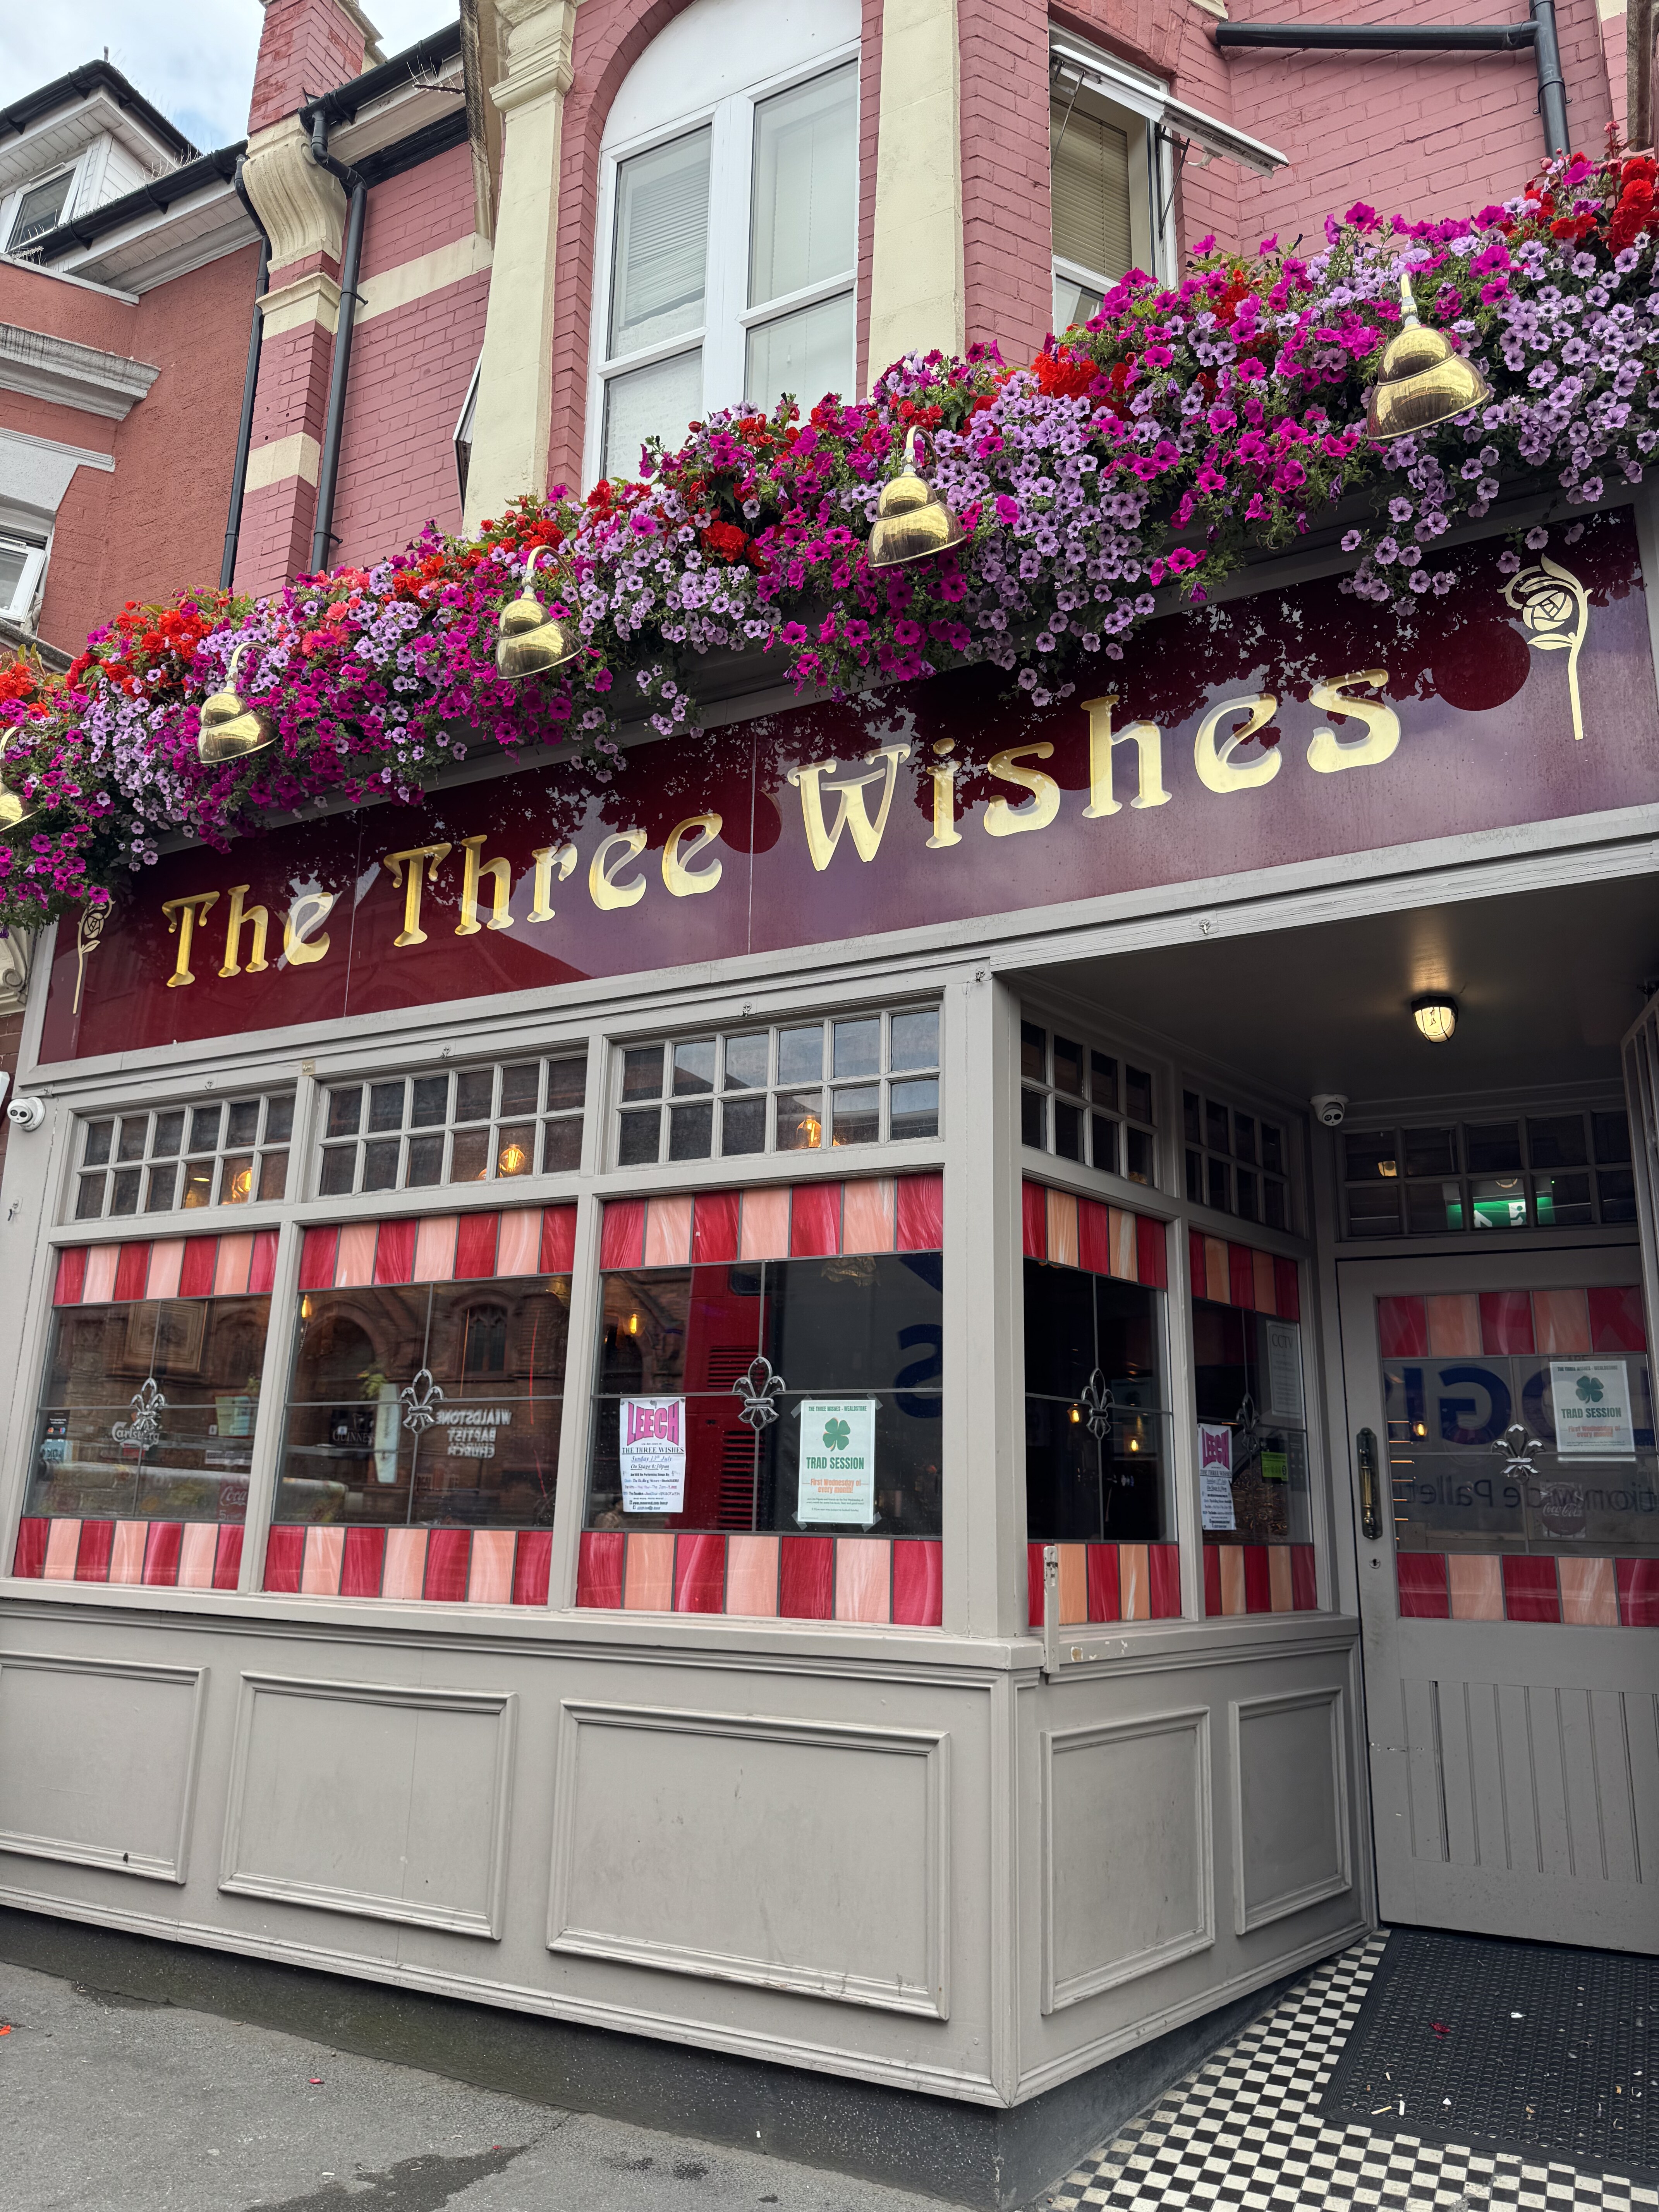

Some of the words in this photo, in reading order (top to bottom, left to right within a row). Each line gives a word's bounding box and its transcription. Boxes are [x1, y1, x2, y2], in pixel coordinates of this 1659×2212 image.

[162, 884, 334, 988] The
[383, 813, 723, 948] Three
[787, 668, 1401, 872] Wishes
[1272, 1334, 1293, 1349] CCTV
[627, 1400, 679, 1446] LEECH
[1561, 1408, 1583, 1419] TRAD
[1586, 1407, 1622, 1418] SESSION
[112, 1421, 161, 1449] Carlsbrg
[806, 1457, 827, 1469] TRAD
[830, 1457, 864, 1469] SESSION
